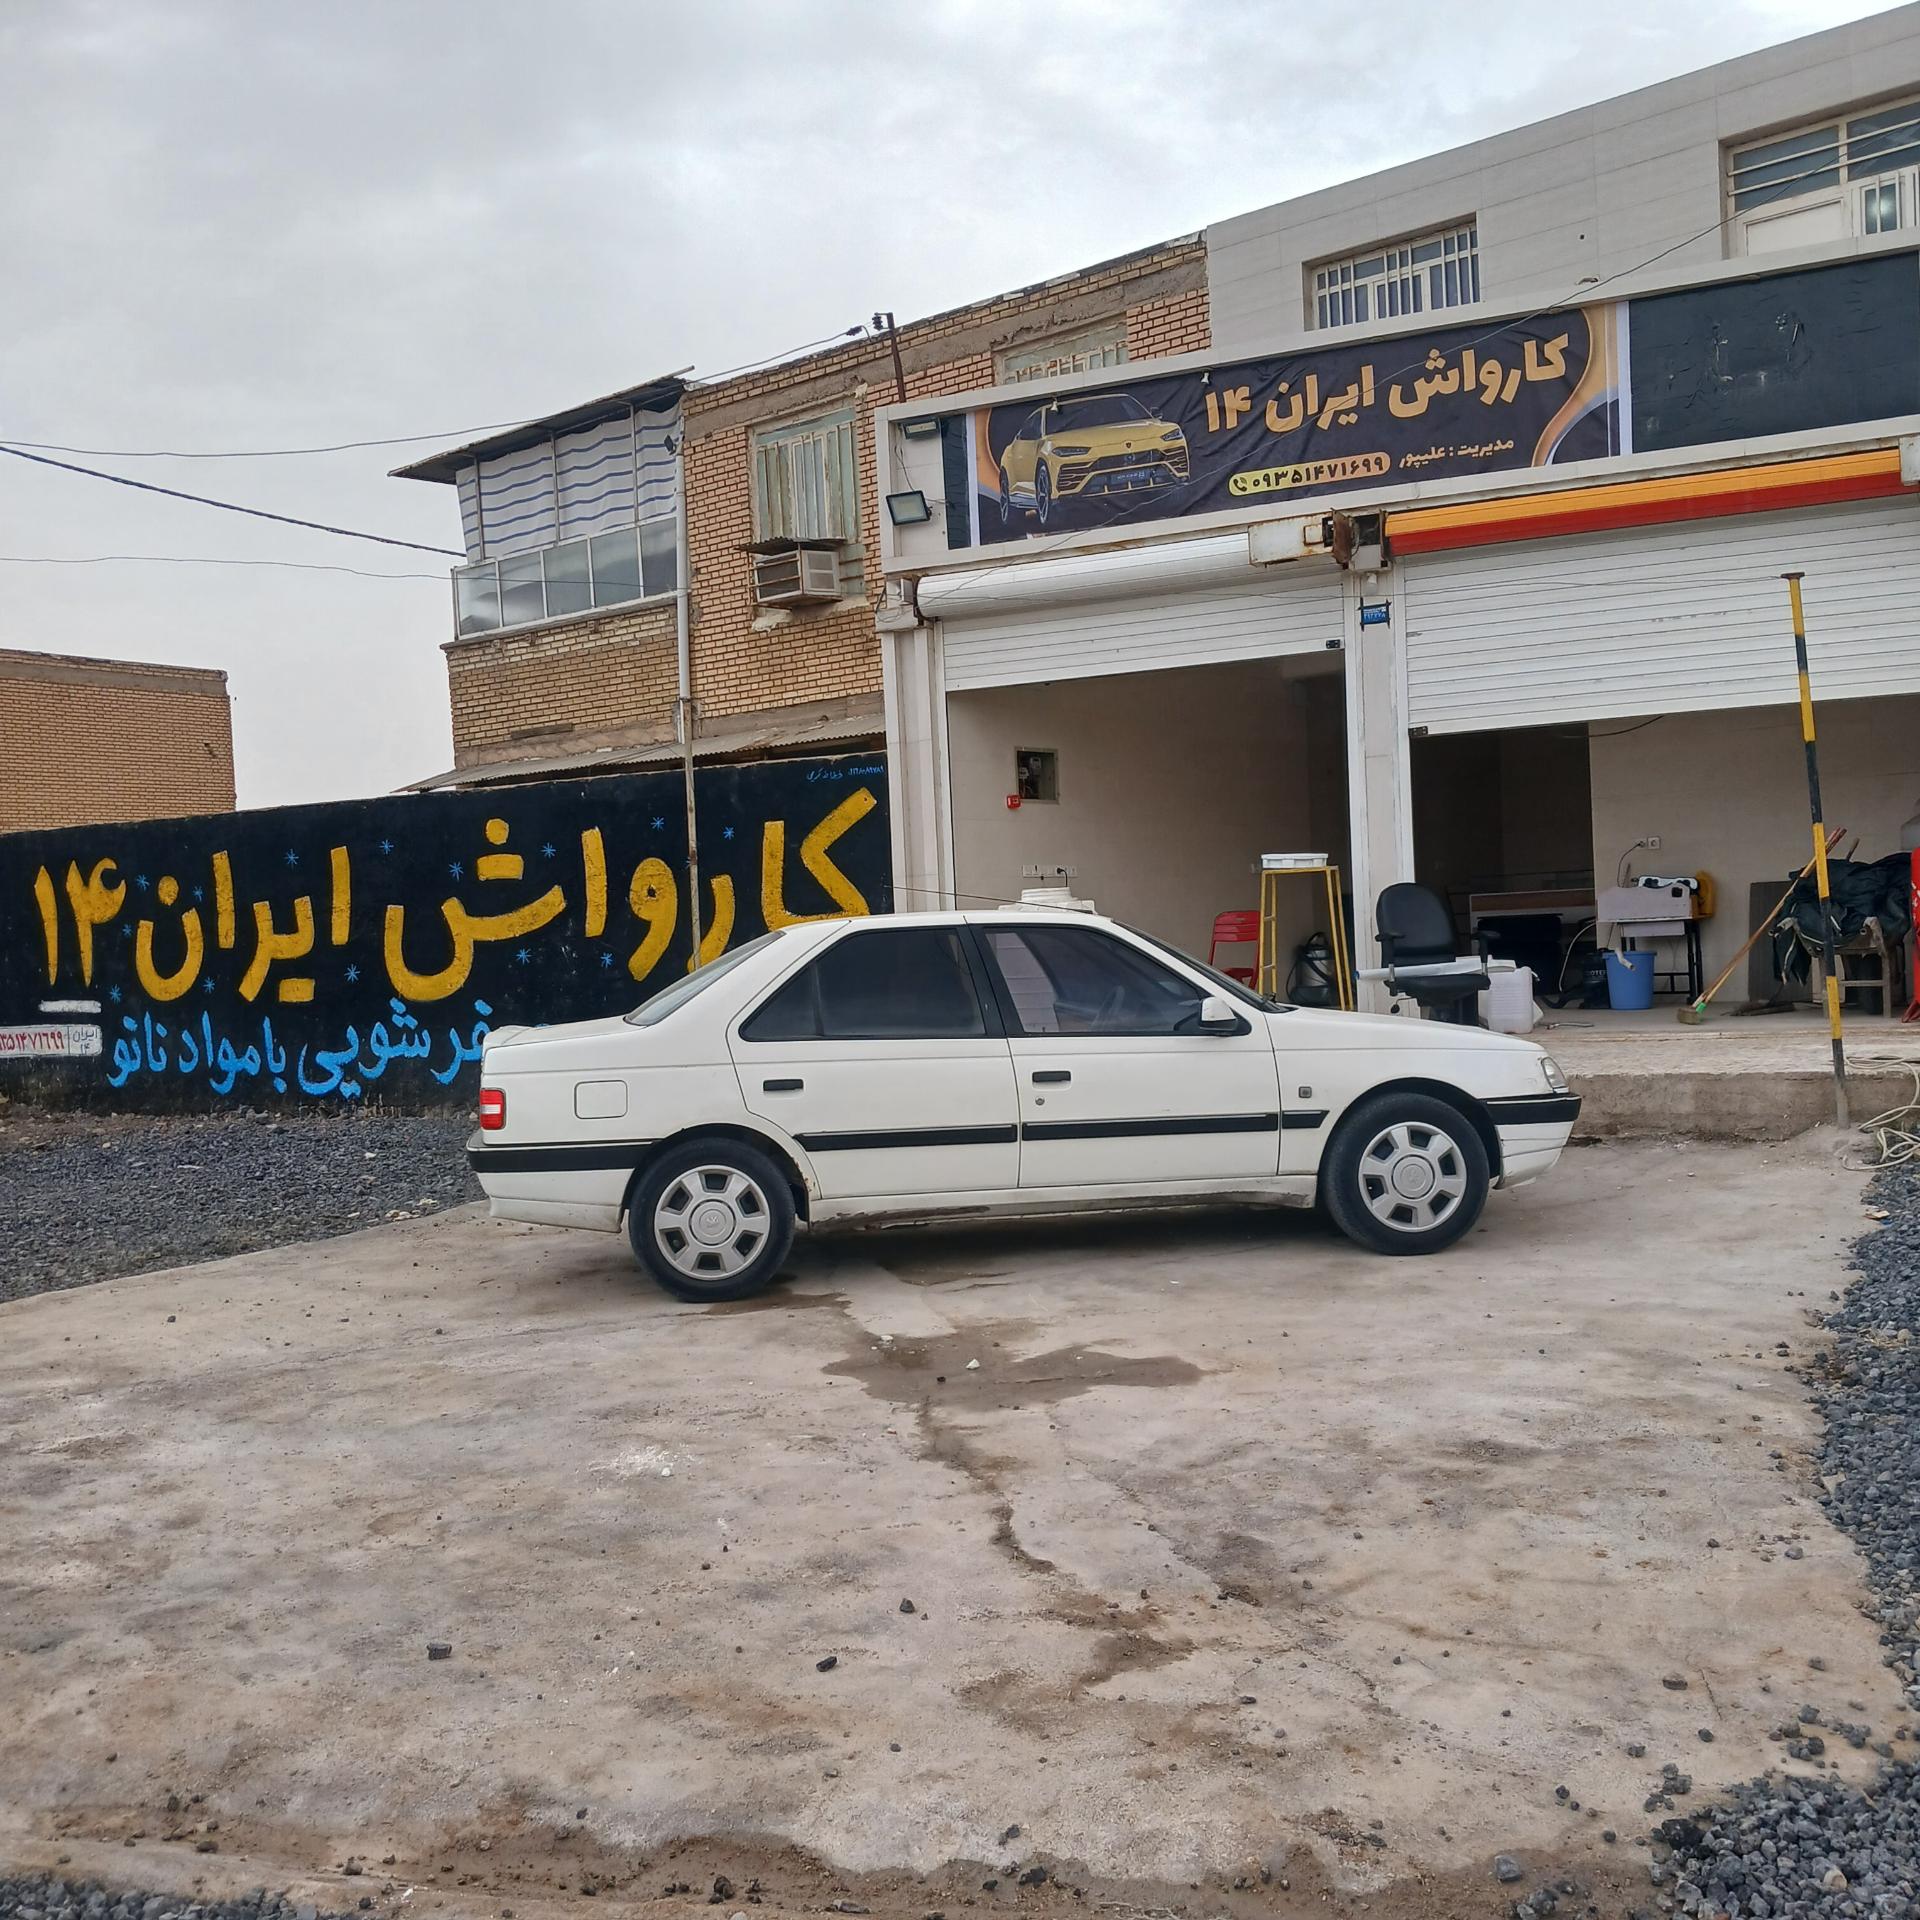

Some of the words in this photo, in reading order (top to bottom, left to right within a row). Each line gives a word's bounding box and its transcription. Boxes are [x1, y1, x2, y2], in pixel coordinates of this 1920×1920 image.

[1205, 386, 1251, 433] ۱۴
[1265, 364, 1375, 433] ایران
[1388, 332, 1569, 418] کارواش
[1252, 456, 1384, 487] ۰۹۳۵۱۴۷۱۶۹۹
[1399, 446, 1445, 468] علیپور
[33, 857, 127, 987] ۱۴
[135, 846, 351, 1002] ایران
[384, 787, 877, 1001] کارواش
[72, 1027, 98, 1042] ایران
[106, 1011, 168, 1088] نانو
